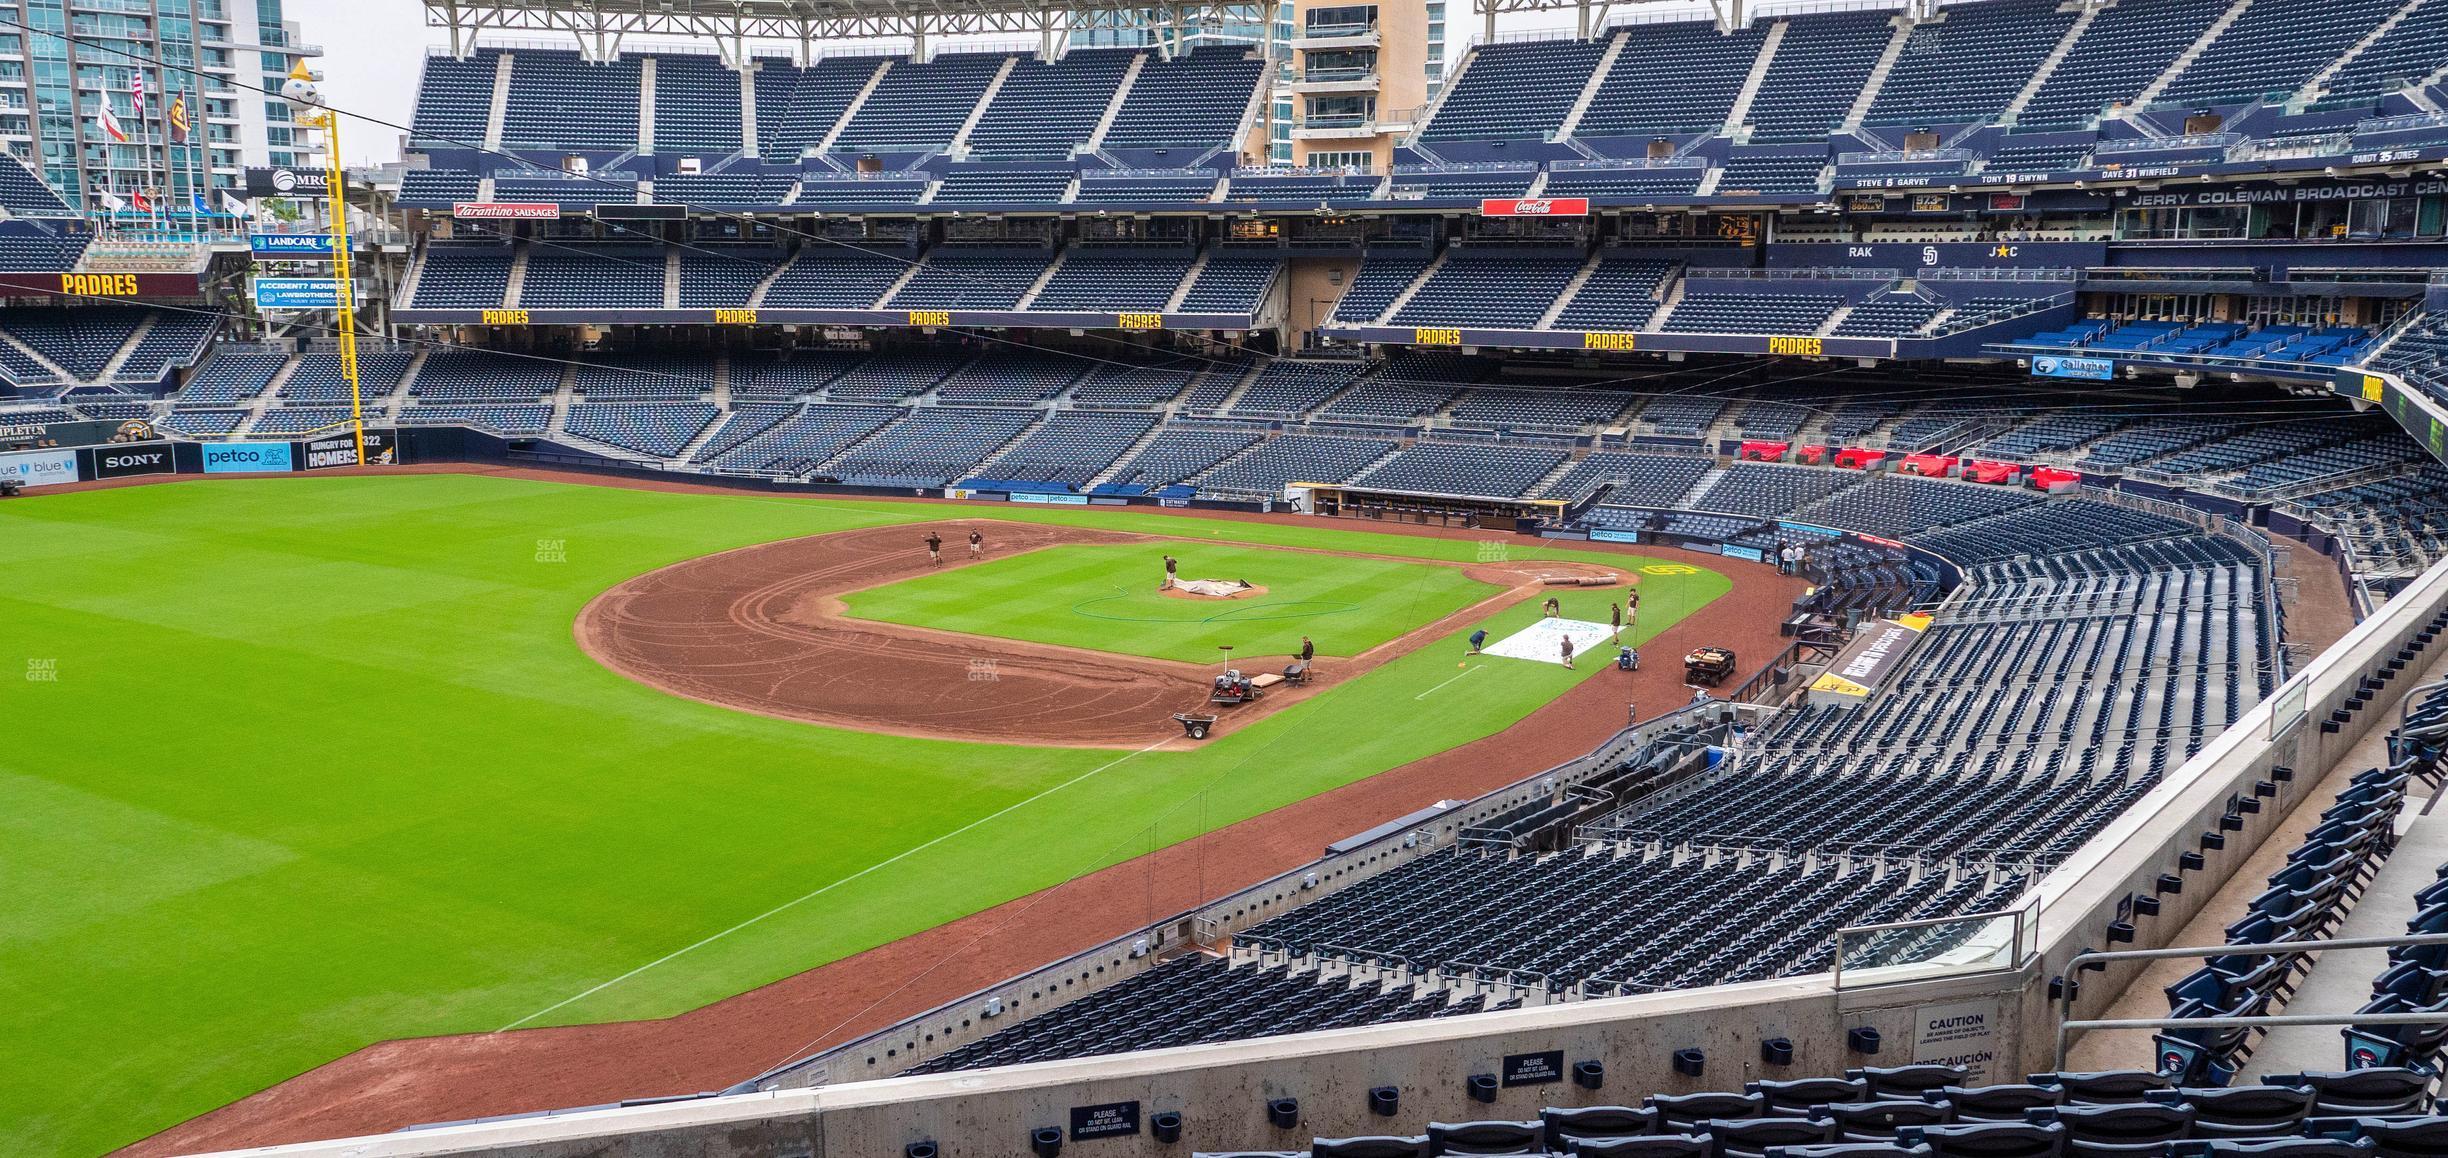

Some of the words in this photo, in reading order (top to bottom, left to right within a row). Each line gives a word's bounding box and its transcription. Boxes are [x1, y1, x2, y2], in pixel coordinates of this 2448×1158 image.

[2352, 153, 2378, 164] RANDY
[2379, 151, 2393, 162] 35
[2393, 150, 2420, 160] JONES
[1982, 176, 2002, 184] TONY
[2005, 174, 2016, 183] 19
[2018, 174, 2048, 182] GWYNN
[2102, 171, 2123, 179] DAVE
[2125, 168, 2138, 178] 31
[2139, 168, 2179, 177] WINFIELD
[1886, 179, 1893, 187] 6
[2132, 193, 2190, 206] JERRY
[2198, 189, 2287, 203] COLEMAN
[2294, 184, 2409, 200] BROADCAST
[457, 204, 513, 217] Tarantino
[515, 209, 558, 217] SAUSAGES
[1514, 200, 1553, 214] Coca-Cola
[268, 237, 318, 246] LANDCARE
[1849, 247, 1873, 257] RAK
[62, 274, 137, 295] PADRES
[483, 310, 528, 324] PADRES
[715, 310, 757, 323] PADRES
[909, 312, 949, 325] PADRES
[1119, 314, 1161, 328] PADRES
[1416, 329, 1460, 344] PADRES
[1585, 333, 1634, 349] PADRES
[1770, 337, 1822, 355] PADRES
[2061, 360, 2110, 372] Gallagher
[0, 425, 47, 436] PLETON
[311, 439, 339, 451] HUNGRY
[340, 439, 353, 449] FOR
[363, 435, 381, 446] 322
[105, 453, 163, 468] SONY
[208, 449, 260, 466] petco
[309, 449, 357, 468] HOMERS
[34, 461, 61, 472] blue
[1011, 493, 1029, 501] petco
[1591, 530, 1613, 539] petco
[1723, 545, 1742, 555] petco
[1929, 1014, 1984, 1030] CAUTION
[1523, 1058, 1544, 1067] PLEASE
[1094, 1110, 1116, 1119] PLEASE
